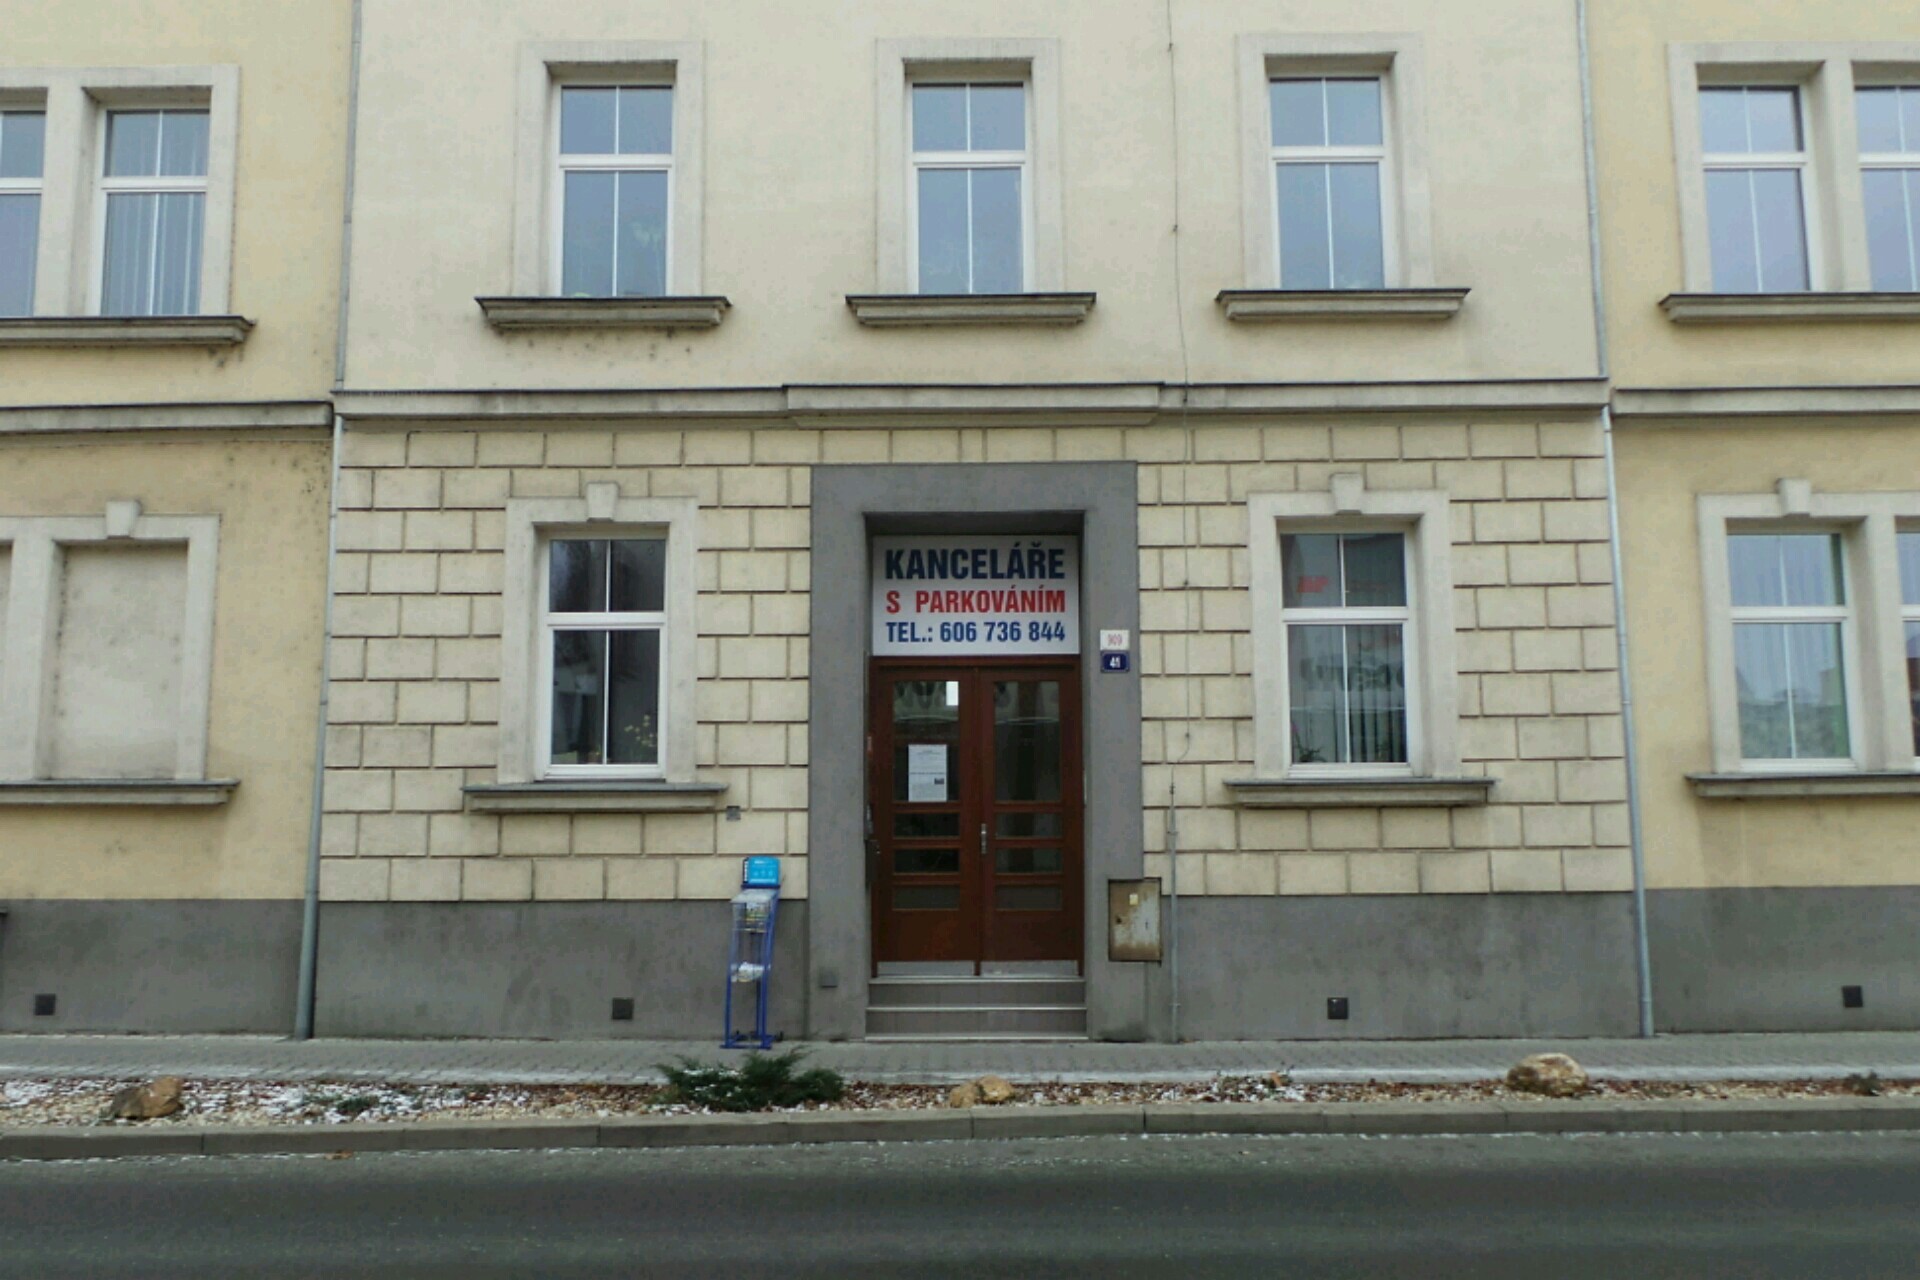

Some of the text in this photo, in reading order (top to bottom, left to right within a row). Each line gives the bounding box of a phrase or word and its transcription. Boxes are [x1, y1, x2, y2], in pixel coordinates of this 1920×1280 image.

[886, 541, 1065, 579] KANCELÁŘE
[886, 584, 1065, 614] S PARKOVÁNÍM
[886, 621, 1066, 643] TEL.: 606 736 844
